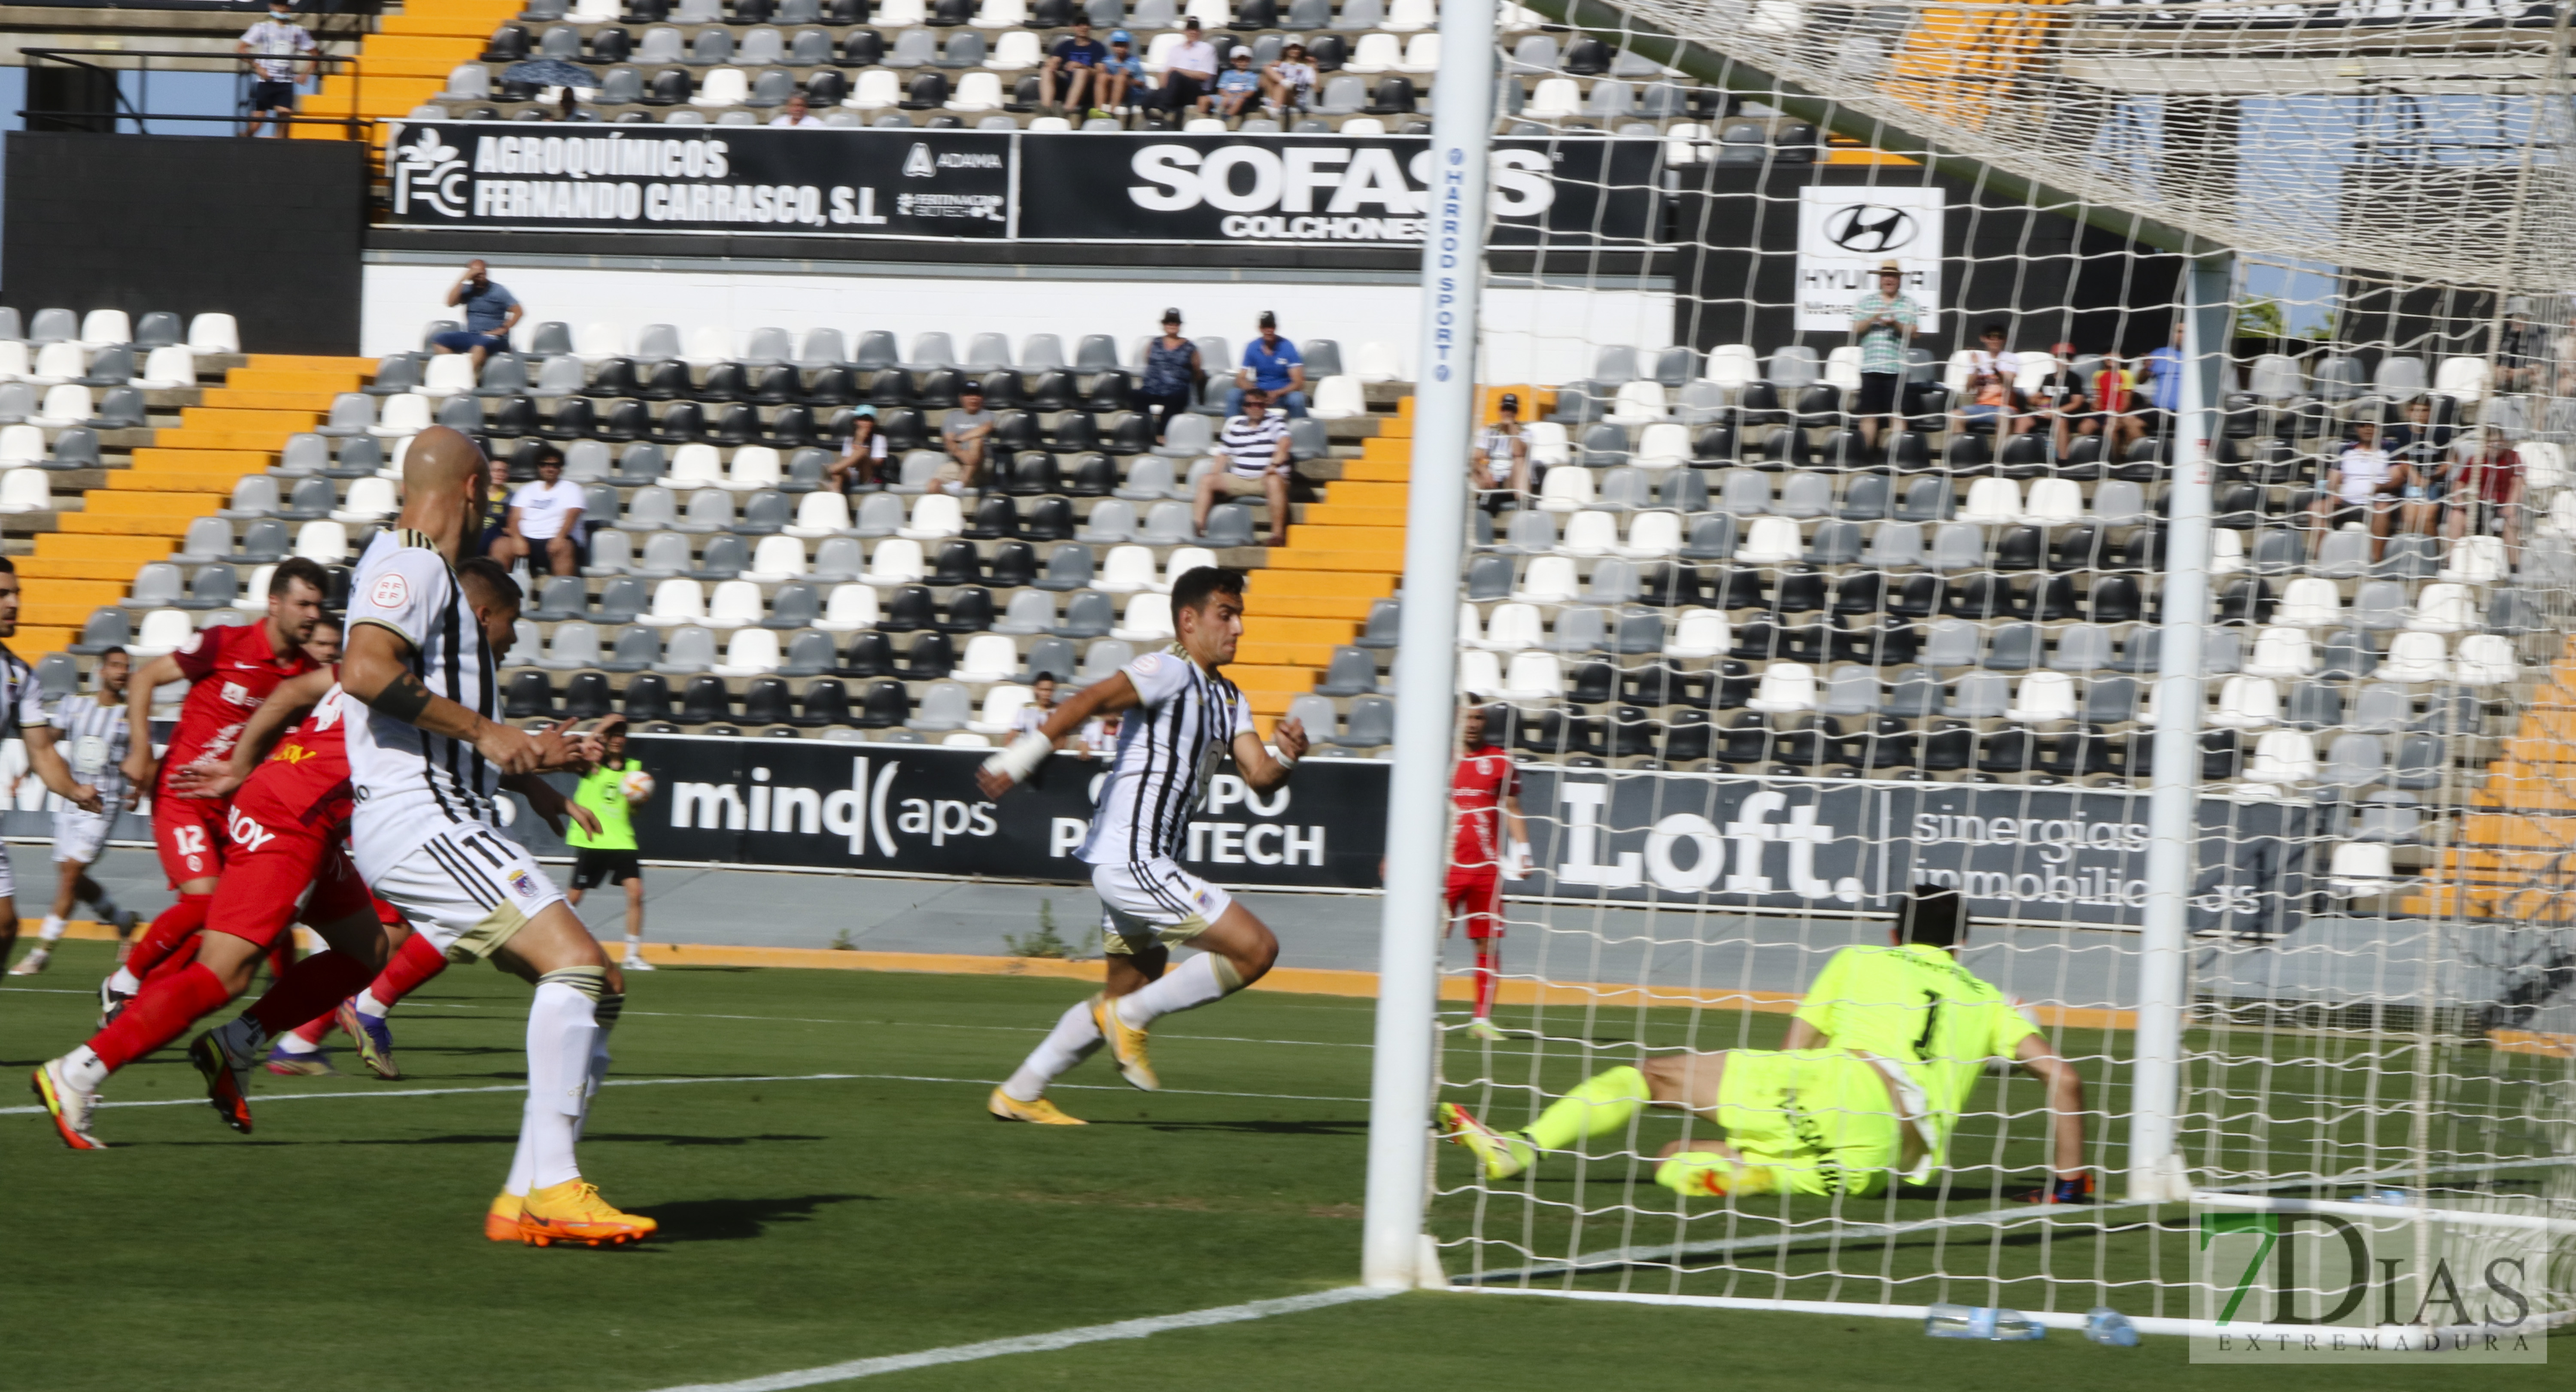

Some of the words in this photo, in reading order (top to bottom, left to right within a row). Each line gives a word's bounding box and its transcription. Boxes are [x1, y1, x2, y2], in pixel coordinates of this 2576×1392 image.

[474, 131, 729, 179] AGROQUÍMICOS
[935, 153, 1003, 168] ADAMA
[474, 179, 641, 220] FERNANDO
[644, 183, 827, 227] CARRASCO,
[829, 186, 887, 224] S.L.
[172, 824, 207, 856] 12
[461, 831, 519, 870] 11
[1558, 781, 1866, 904] Loft.
[1913, 804, 2148, 864] sinergias
[1165, 870, 1192, 893] 7
